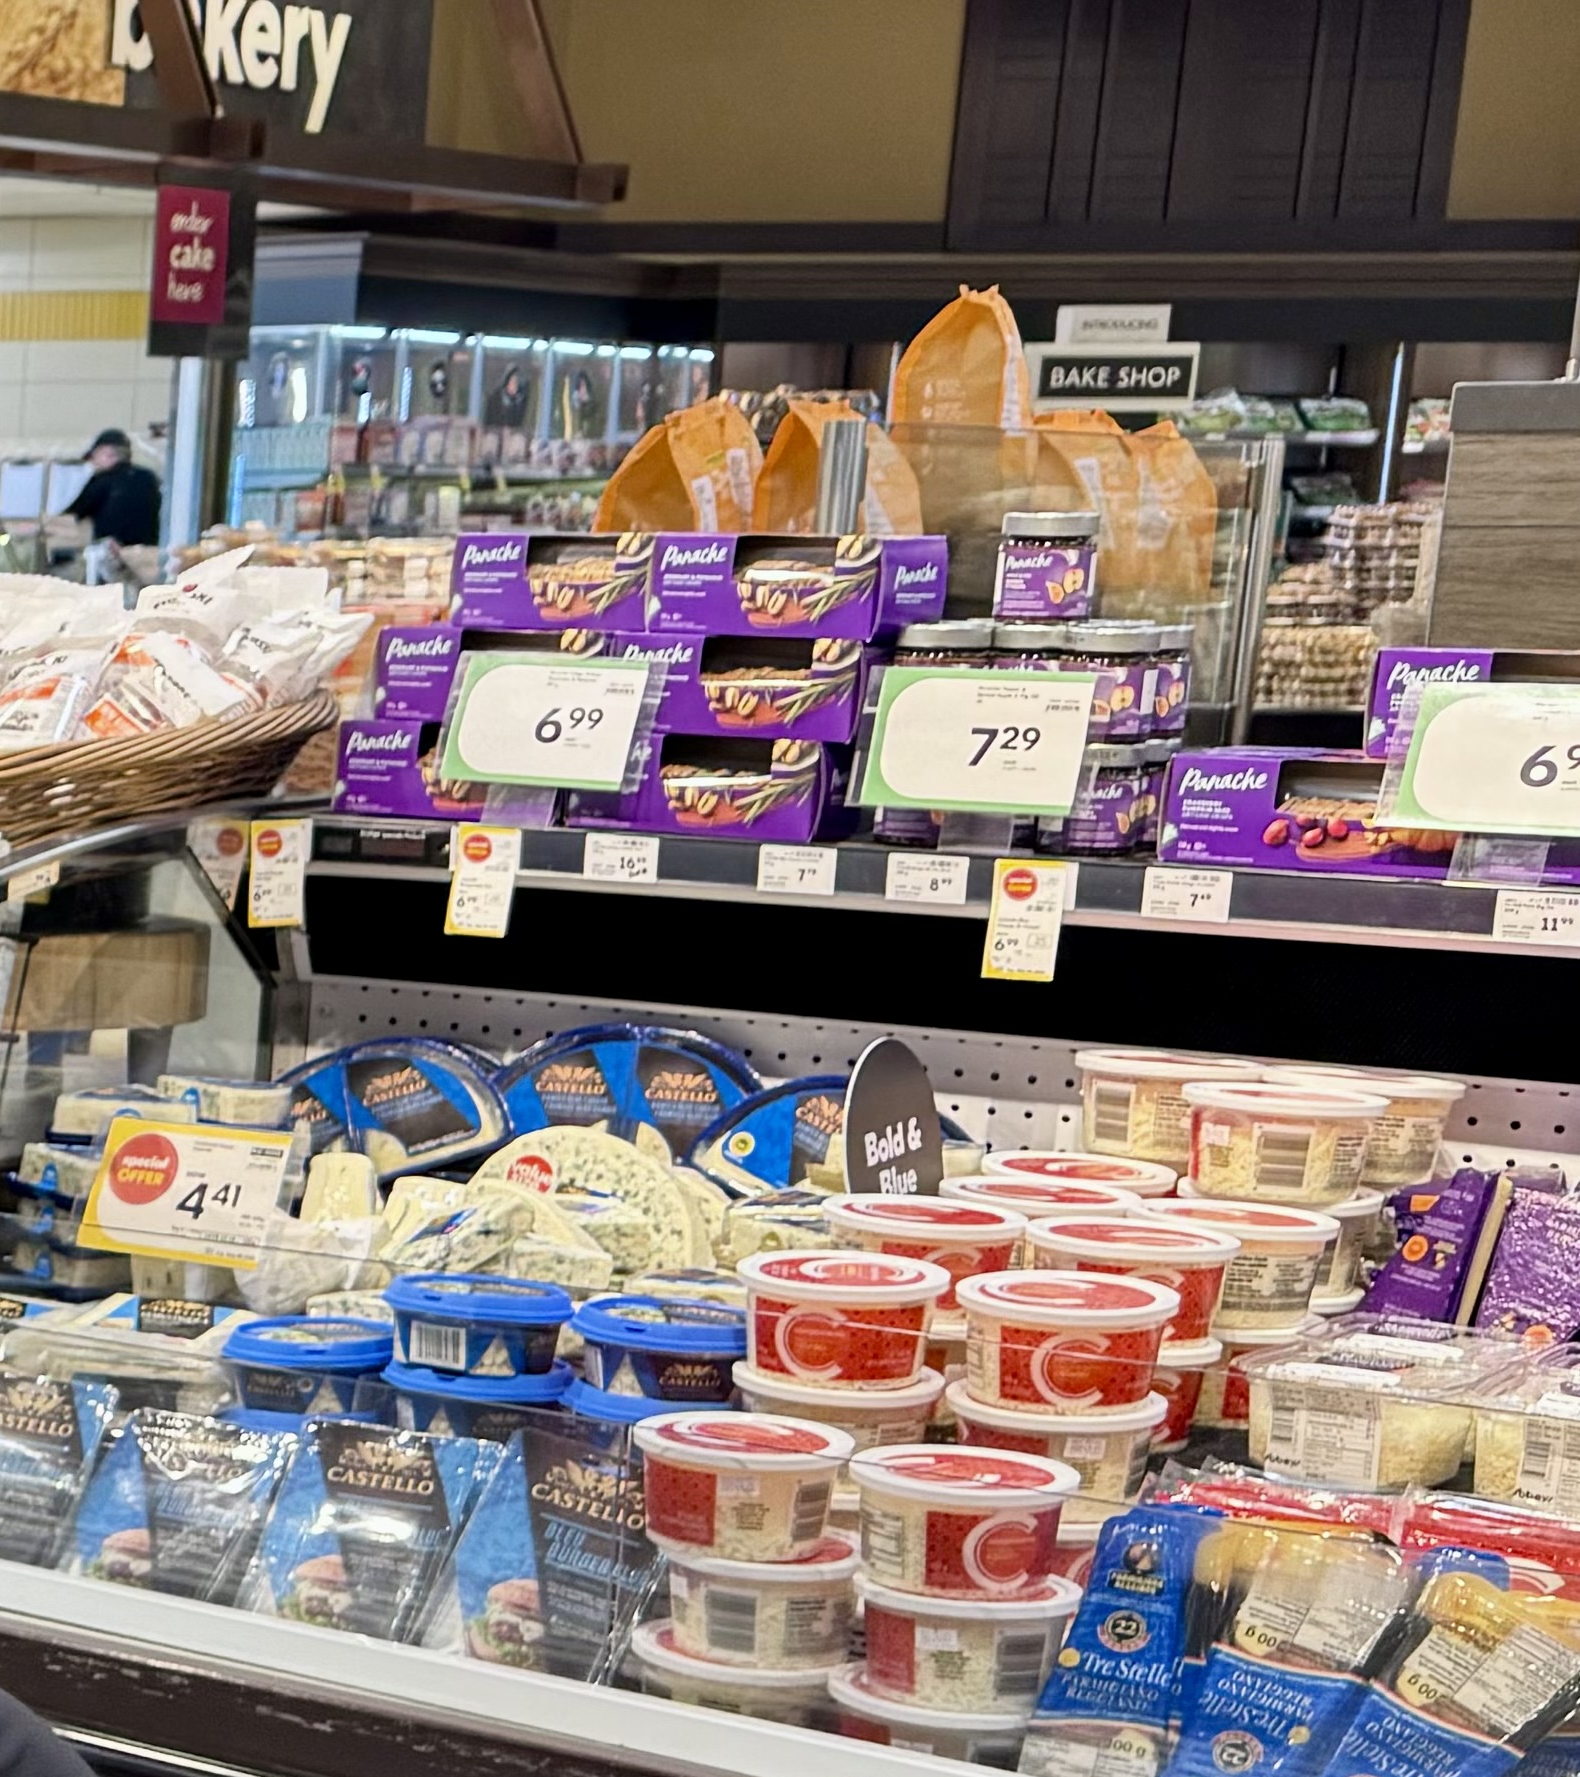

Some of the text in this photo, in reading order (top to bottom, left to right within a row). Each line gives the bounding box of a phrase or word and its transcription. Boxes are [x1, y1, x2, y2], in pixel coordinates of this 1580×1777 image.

[111, 0, 353, 134] bkery
[169, 237, 216, 272] cake
[167, 274, 204, 302] here
[1081, 317, 1159, 331] INTRODUCING
[1049, 365, 1182, 389] BAKE SHOP
[461, 540, 522, 570] Panache
[660, 542, 728, 571] Panache
[1005, 553, 1055, 571] Panache
[894, 562, 939, 590] Panache
[385, 634, 453, 663] Panache
[622, 642, 694, 662] Panache
[1386, 659, 1481, 690] Panache
[345, 729, 414, 756] Panache
[1178, 767, 1269, 796] Panache
[362, 1079, 428, 1107] CASTELLO
[535, 1081, 607, 1096] CASTELLO
[644, 1087, 719, 1103] CASTELLO
[864, 1116, 923, 1167] Bold &
[116, 1167, 165, 1186] OFFER
[121, 1154, 170, 1170] special
[878, 1166, 919, 1195] Blue
[773, 1305, 847, 1382] C
[659, 1375, 722, 1388] CASTELLO
[1029, 1330, 1112, 1408] C
[327, 1465, 435, 1496] CASTELLO
[530, 1482, 644, 1530] CASTELLO
[961, 1512, 1040, 1593] C
[1114, 1619, 1139, 1636] 22
[1081, 1652, 1172, 1688] Tre Stelle
[1061, 1673, 1160, 1701] PARMIGIANO
[1065, 1688, 1149, 1712] REGGIANO
[1217, 1677, 1315, 1722] PARMIGIANO
[1232, 1669, 1314, 1706] REGGIANO
[1198, 1690, 1288, 1740] Tre Stelle
[1221, 1746, 1246, 1765] 22
[1343, 1729, 1395, 1773] Stelle
[1382, 1715, 1457, 1767] REGGIANO
